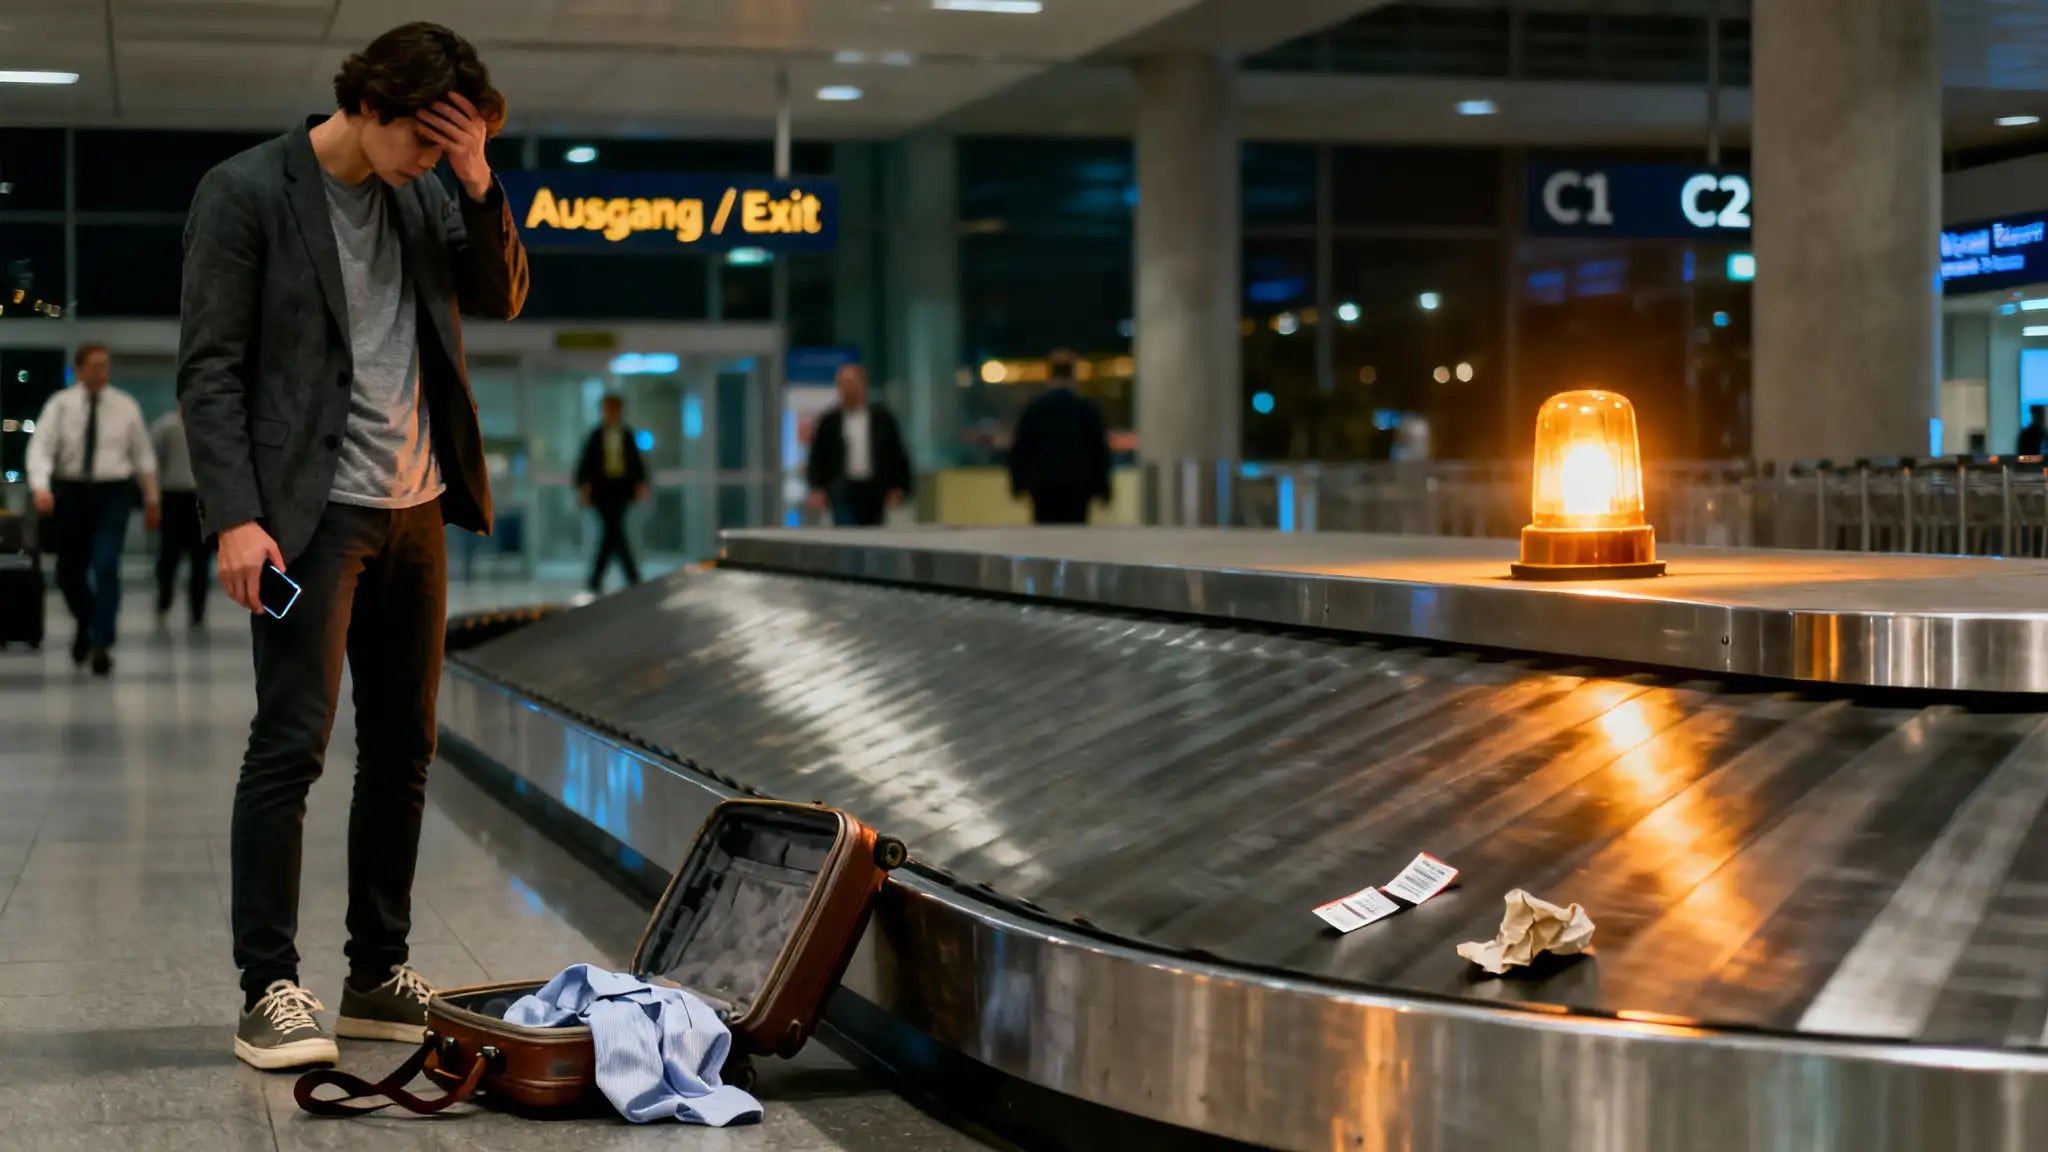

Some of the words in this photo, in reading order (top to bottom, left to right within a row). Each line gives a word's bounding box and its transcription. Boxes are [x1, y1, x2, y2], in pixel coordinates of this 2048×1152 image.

[525, 187, 703, 242] Ausgang
[710, 187, 737, 235] /
[742, 189, 822, 234] Exit
[1543, 171, 1613, 225] C1
[1681, 173, 1751, 228] C2
